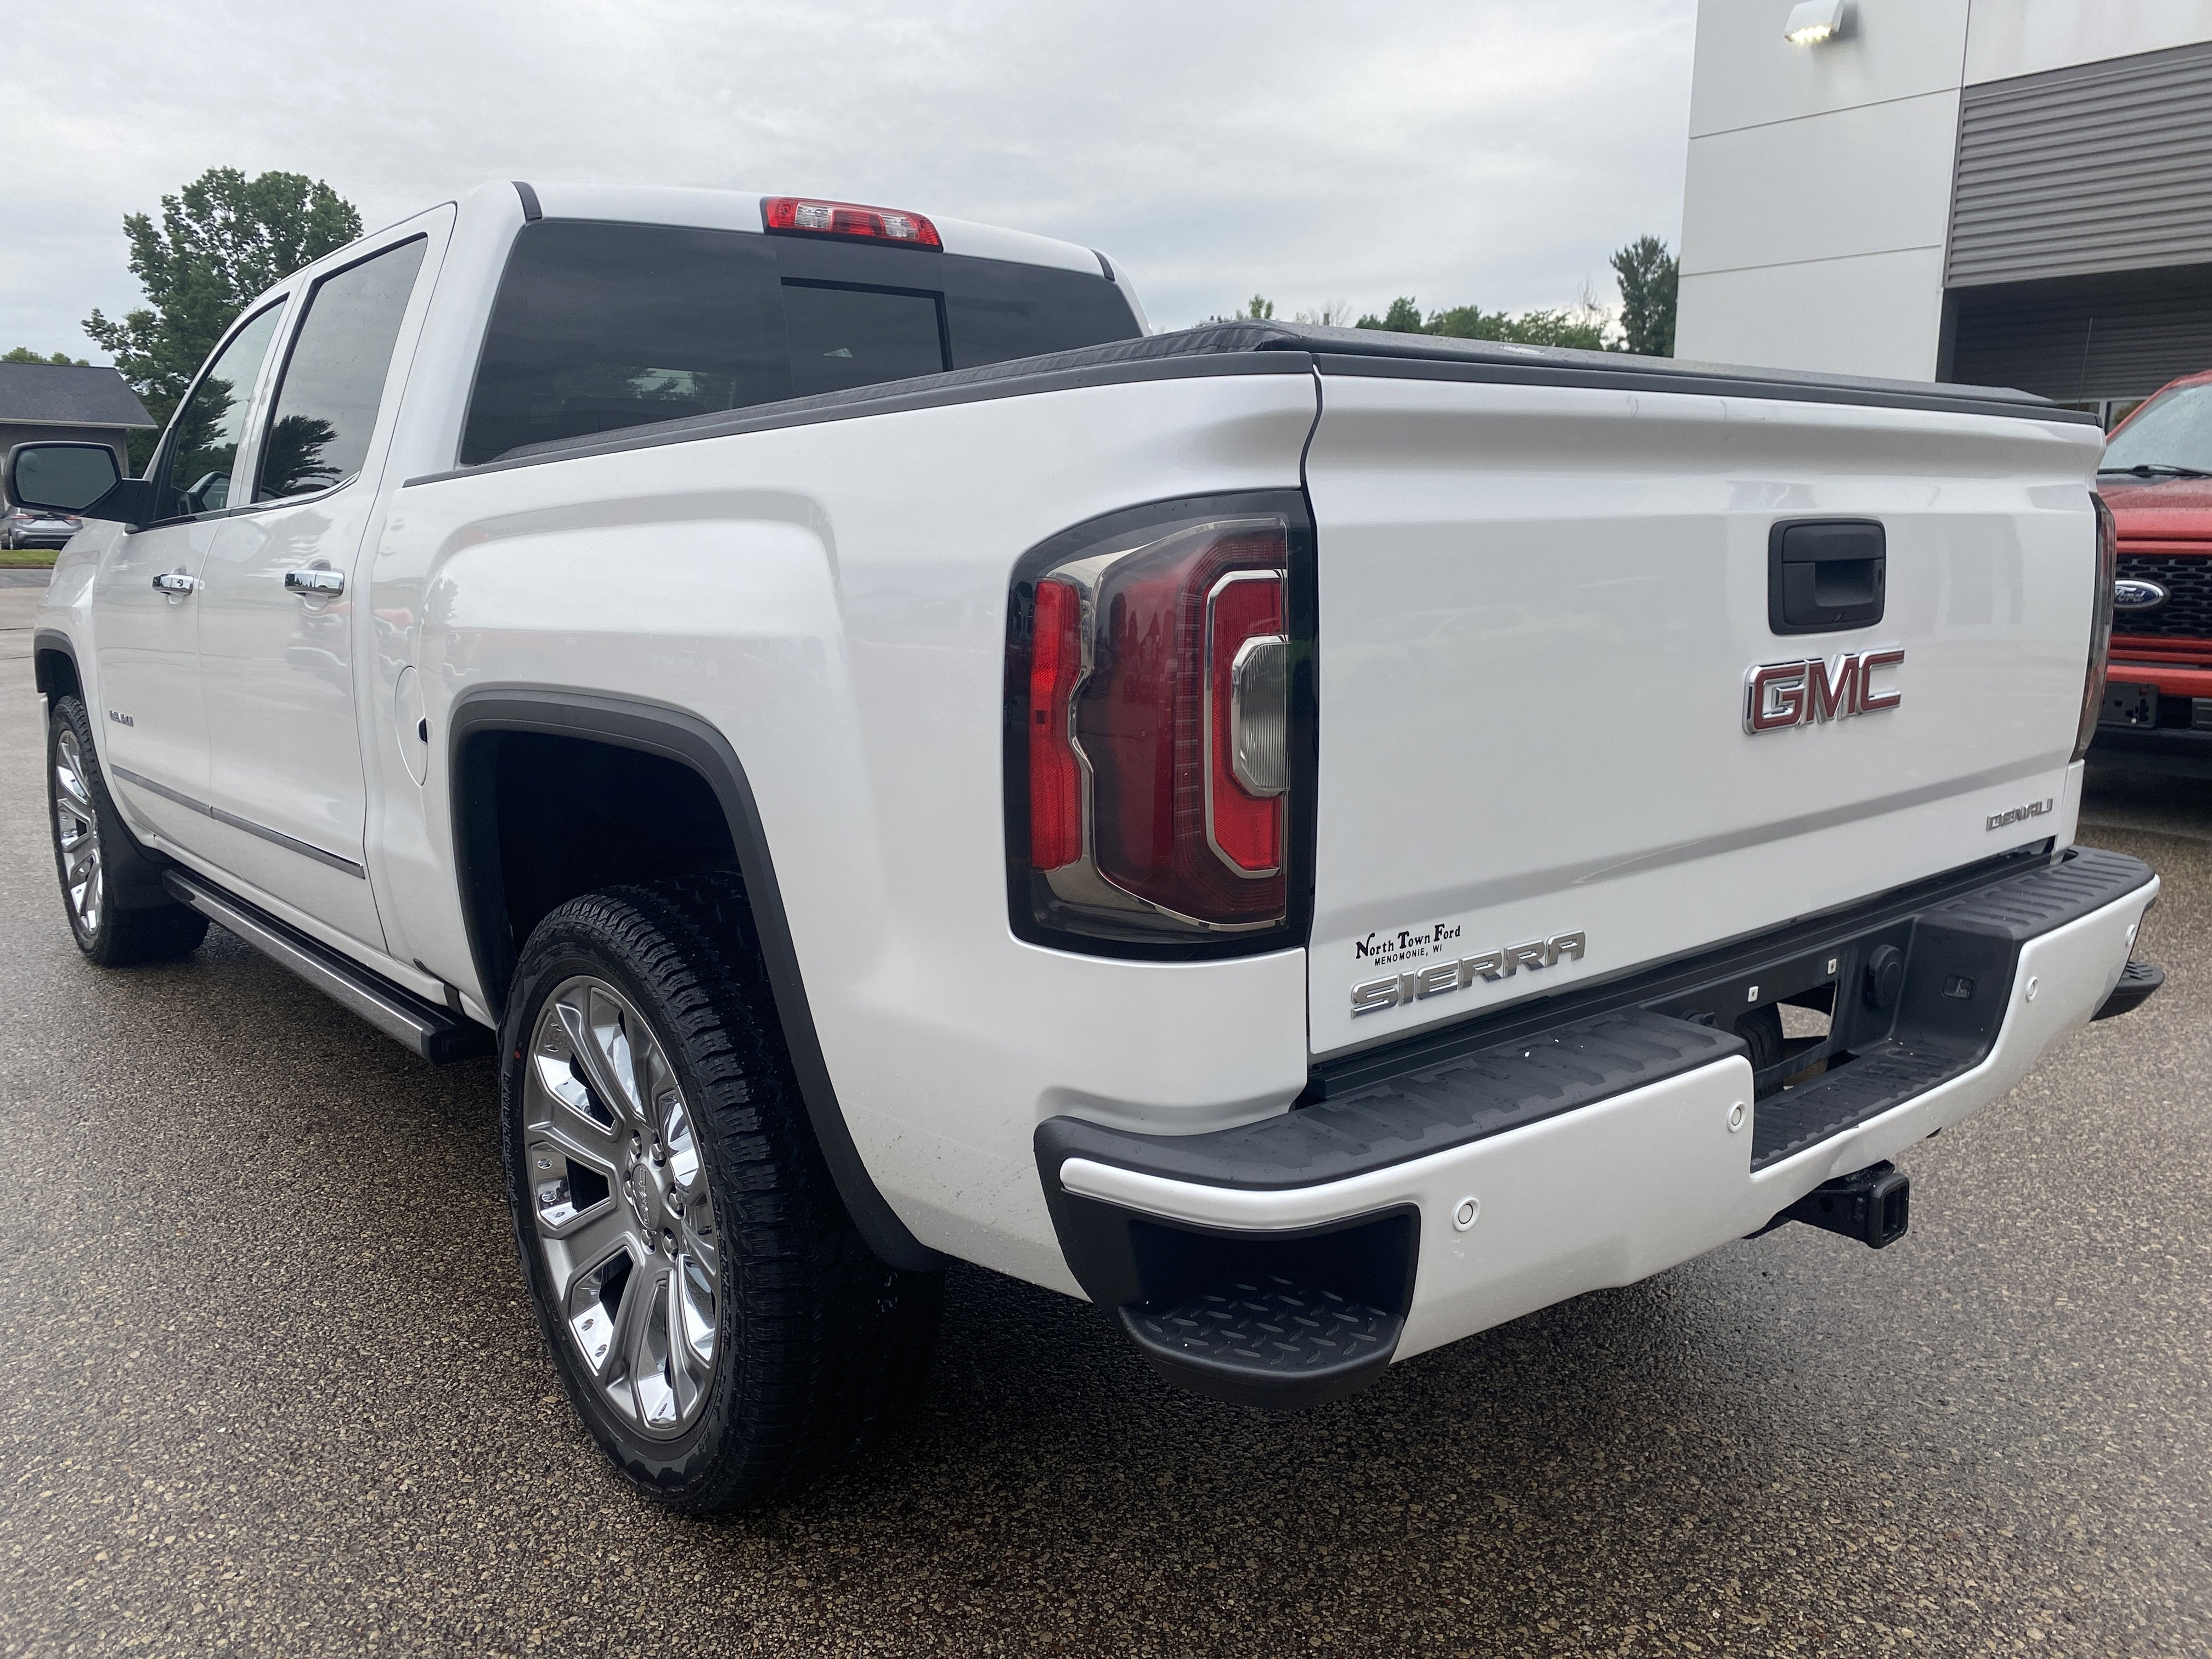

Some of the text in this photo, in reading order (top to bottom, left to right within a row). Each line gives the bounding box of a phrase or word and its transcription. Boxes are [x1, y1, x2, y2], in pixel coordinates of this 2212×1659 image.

[1742, 646, 1905, 735] GMC
[1986, 798, 2053, 832] DENALI
[1356, 923, 1460, 959] North Town Ford
[1374, 944, 1442, 967] MENOMONIE, WI
[1350, 929, 1586, 1019] SIERRA
